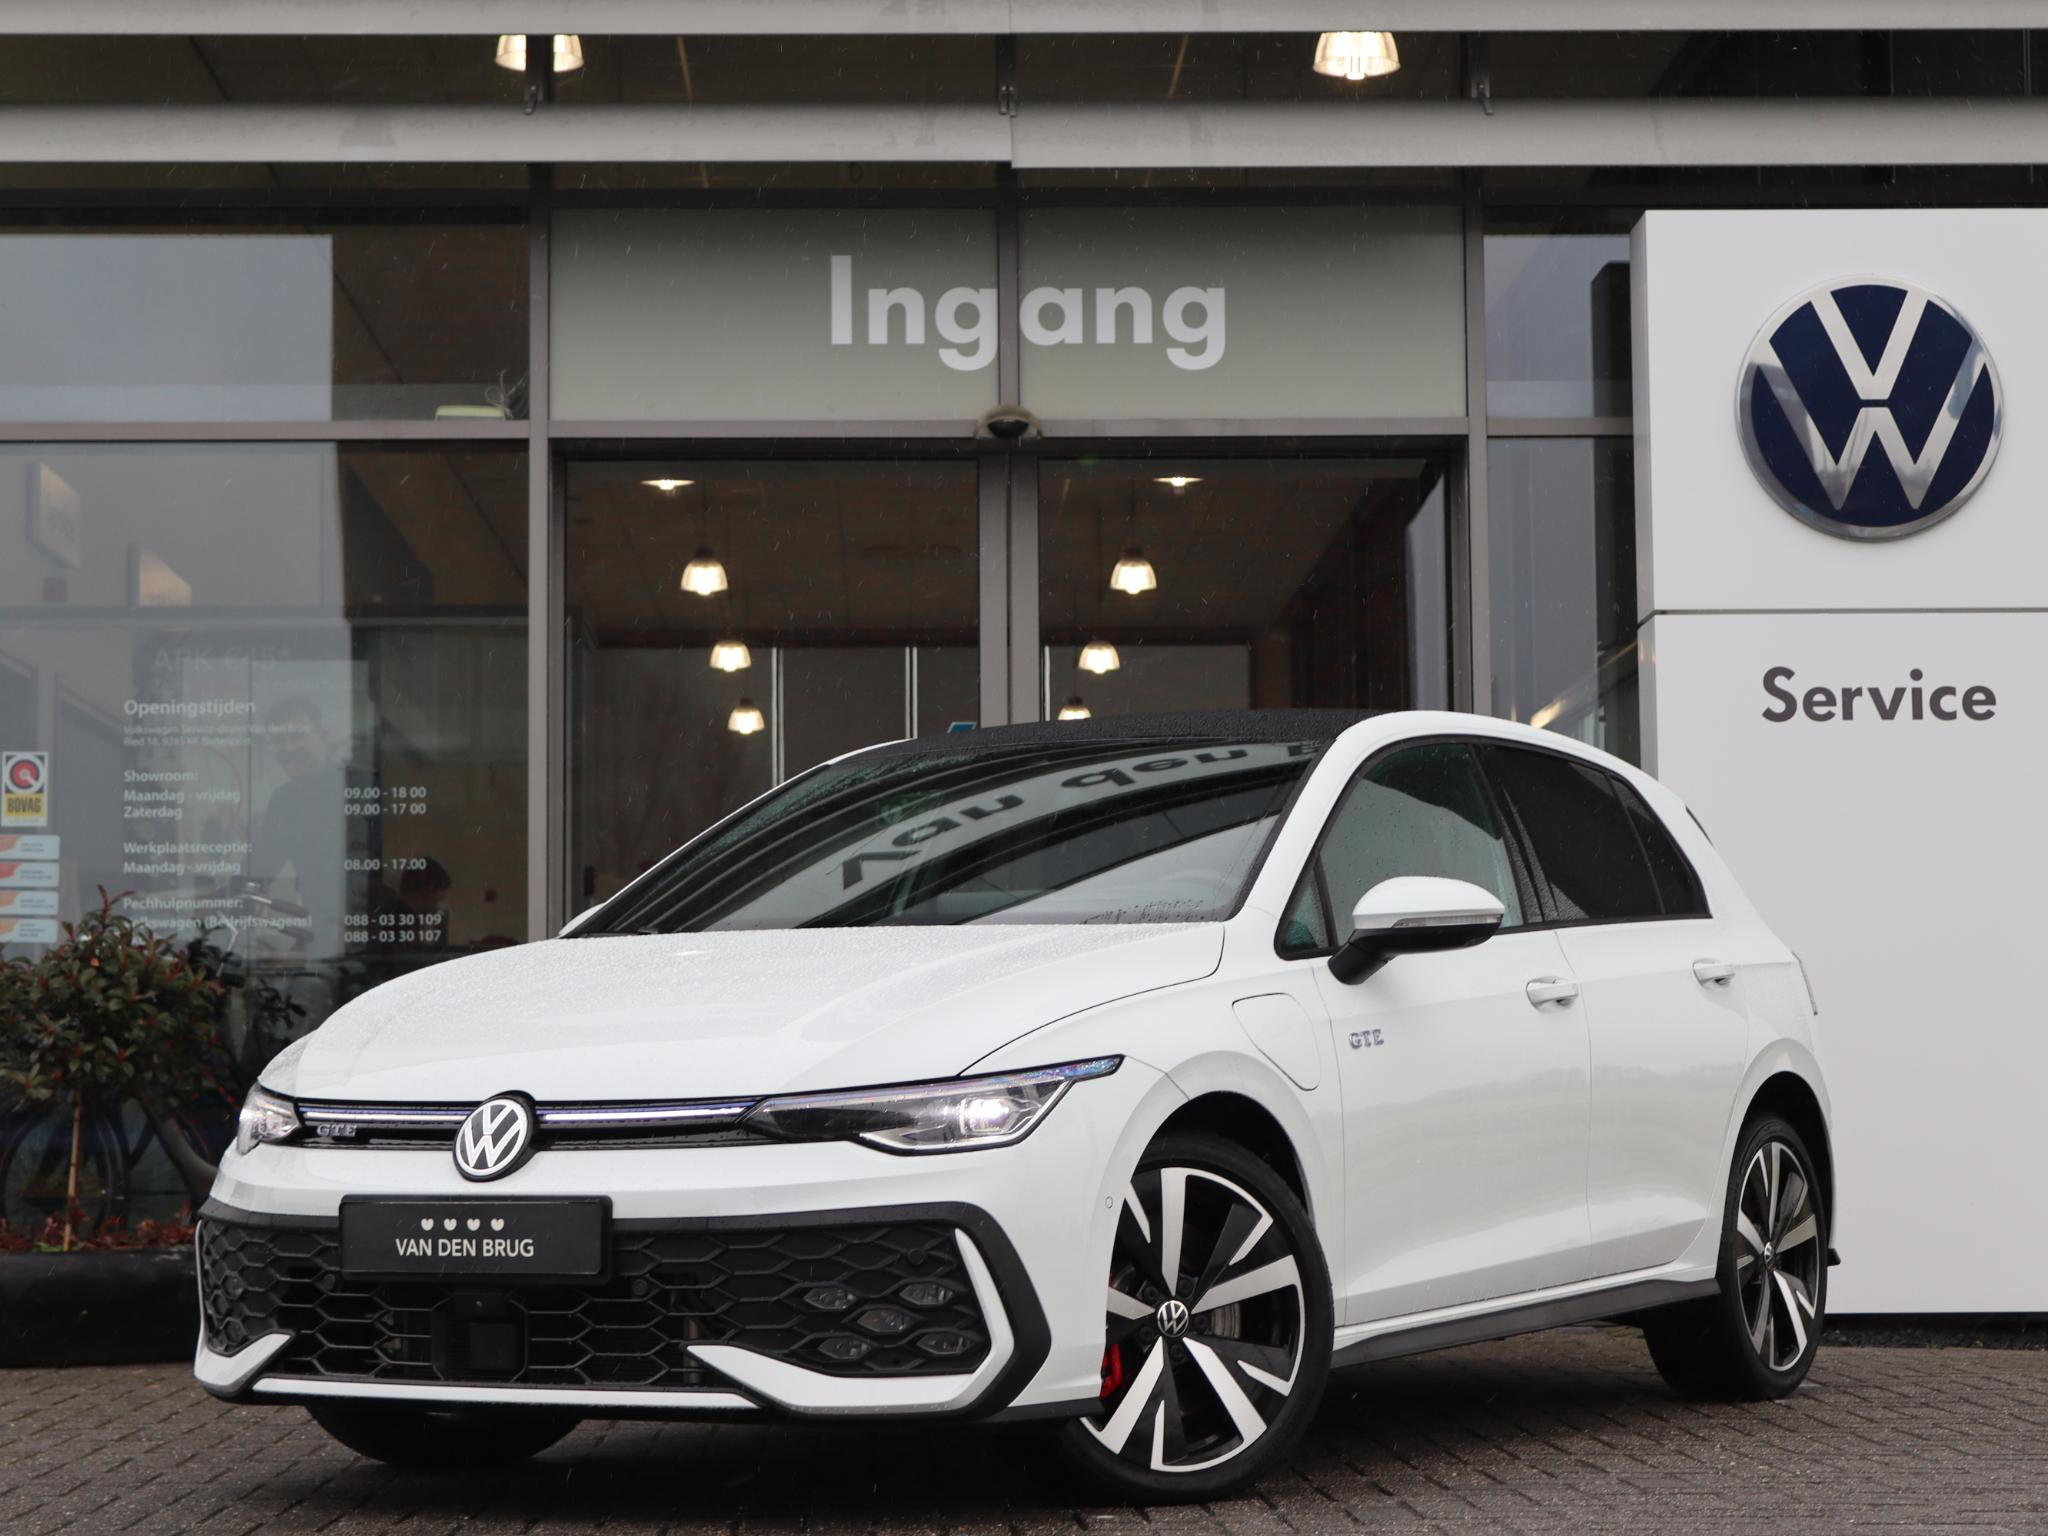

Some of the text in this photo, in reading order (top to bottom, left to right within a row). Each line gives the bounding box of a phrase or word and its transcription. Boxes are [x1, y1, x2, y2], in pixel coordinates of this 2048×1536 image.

[831, 255, 1226, 371] Ingang
[1761, 665, 1997, 723] Service
[123, 699, 256, 719] Openingstijden
[123, 769, 198, 783] Showroom:
[123, 789, 185, 804] Maandag
[195, 788, 241, 804] vrijdag
[344, 786, 381, 799] 09.00
[8, 797, 41, 813] BOVAG
[123, 805, 183, 820] Zaterdag
[344, 803, 381, 815] 09.00
[123, 842, 252, 856] Werkplaatsreceptie:
[123, 861, 185, 876] Maandag
[195, 860, 241, 876] vrijdag
[344, 858, 381, 871] 08.00
[391, 858, 427, 870] 17.00
[123, 896, 244, 912] Pechhulpnummer:
[344, 914, 369, 926] 088
[379, 914, 396, 926] 03
[398, 913, 415, 925] 30
[418, 913, 442, 926] 109
[344, 931, 369, 943] 088
[379, 930, 396, 942] 03
[398, 930, 415, 942] 30
[418, 929, 442, 942] 107
[1349, 1028, 1385, 1050] GTE
[316, 1123, 358, 1138] GTE
[396, 1238, 535, 1258] VAN DEN BRUG
